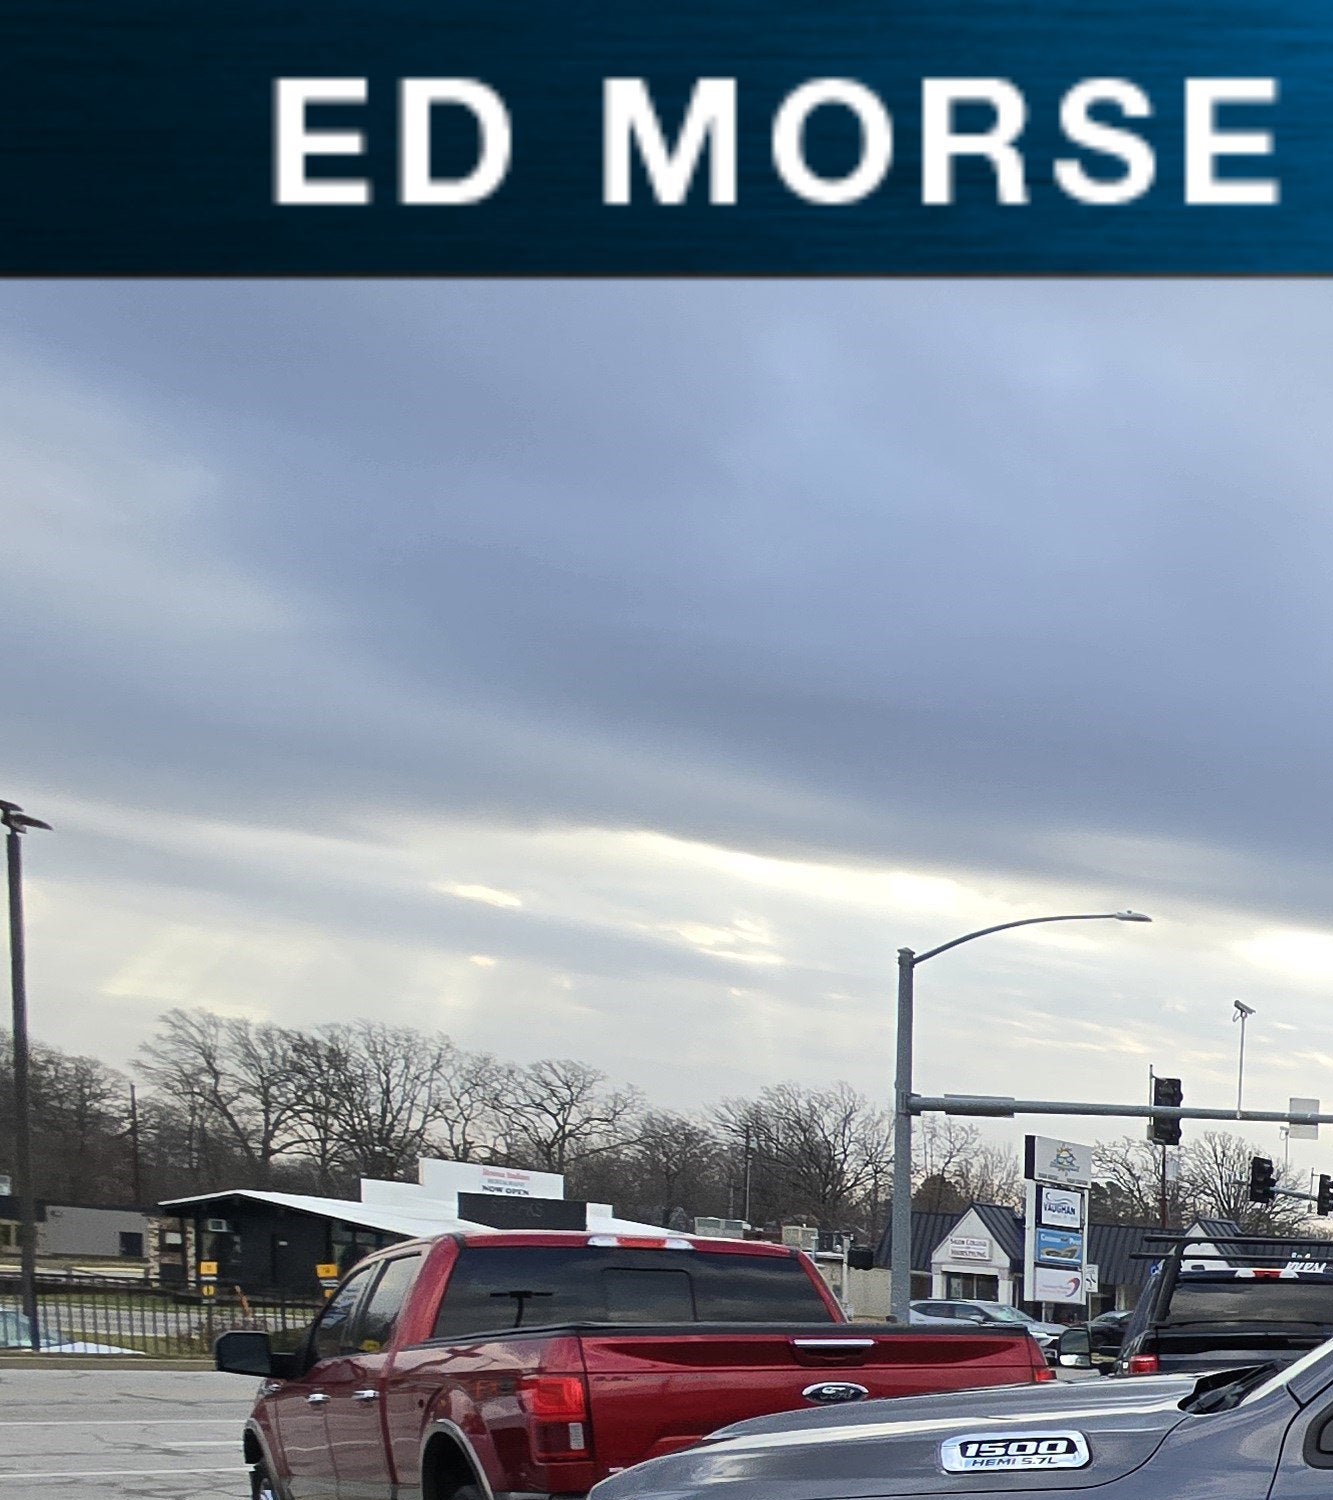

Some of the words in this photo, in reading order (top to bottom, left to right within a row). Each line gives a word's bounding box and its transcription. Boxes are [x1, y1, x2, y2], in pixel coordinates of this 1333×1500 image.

[965, 1440, 1069, 1457] 1500
[972, 1459, 1017, 1467] HEMI
[1021, 1456, 1059, 1465] 5.7L
